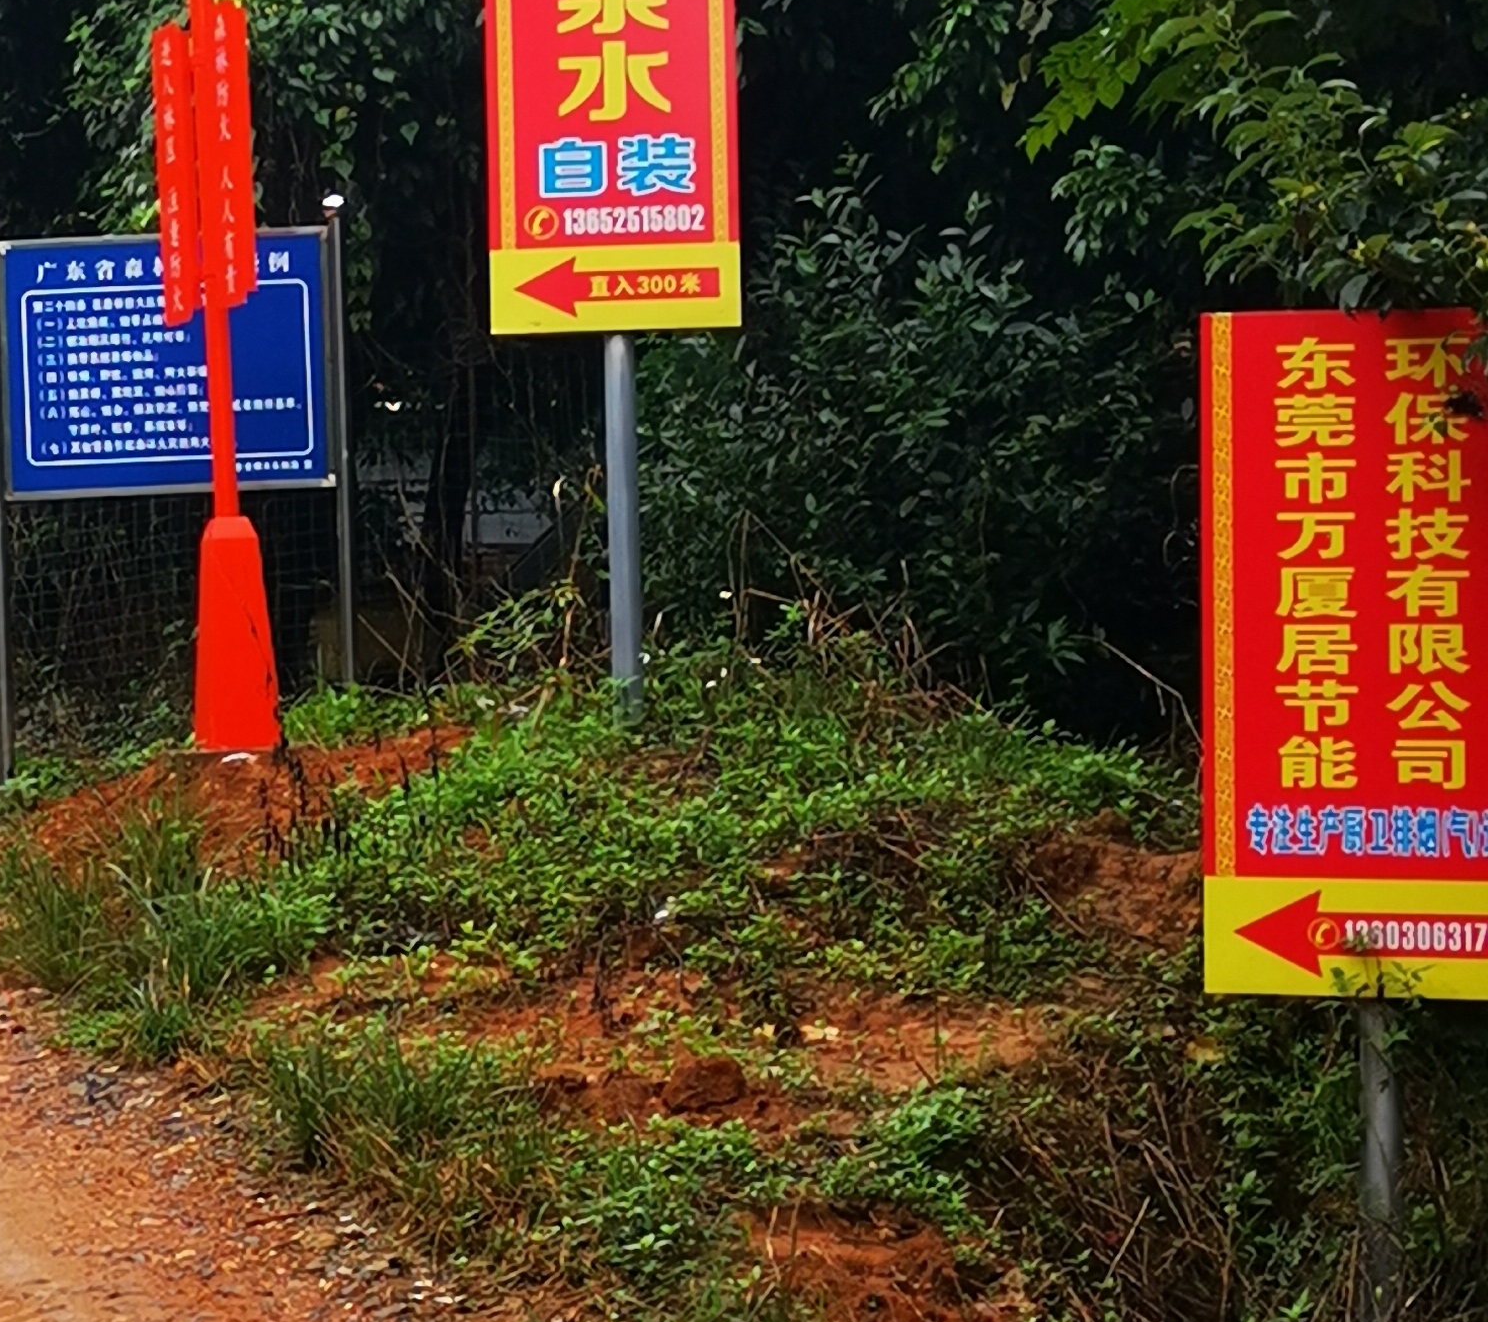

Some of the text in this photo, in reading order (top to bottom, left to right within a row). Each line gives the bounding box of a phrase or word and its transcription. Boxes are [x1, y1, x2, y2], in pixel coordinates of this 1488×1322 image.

[538, 133, 696, 198] 自装
[588, 272, 702, 298] 直入300米
[1275, 338, 1358, 788] 东莞市万厦居节能
[1386, 340, 1470, 789] 环保科技有限公司
